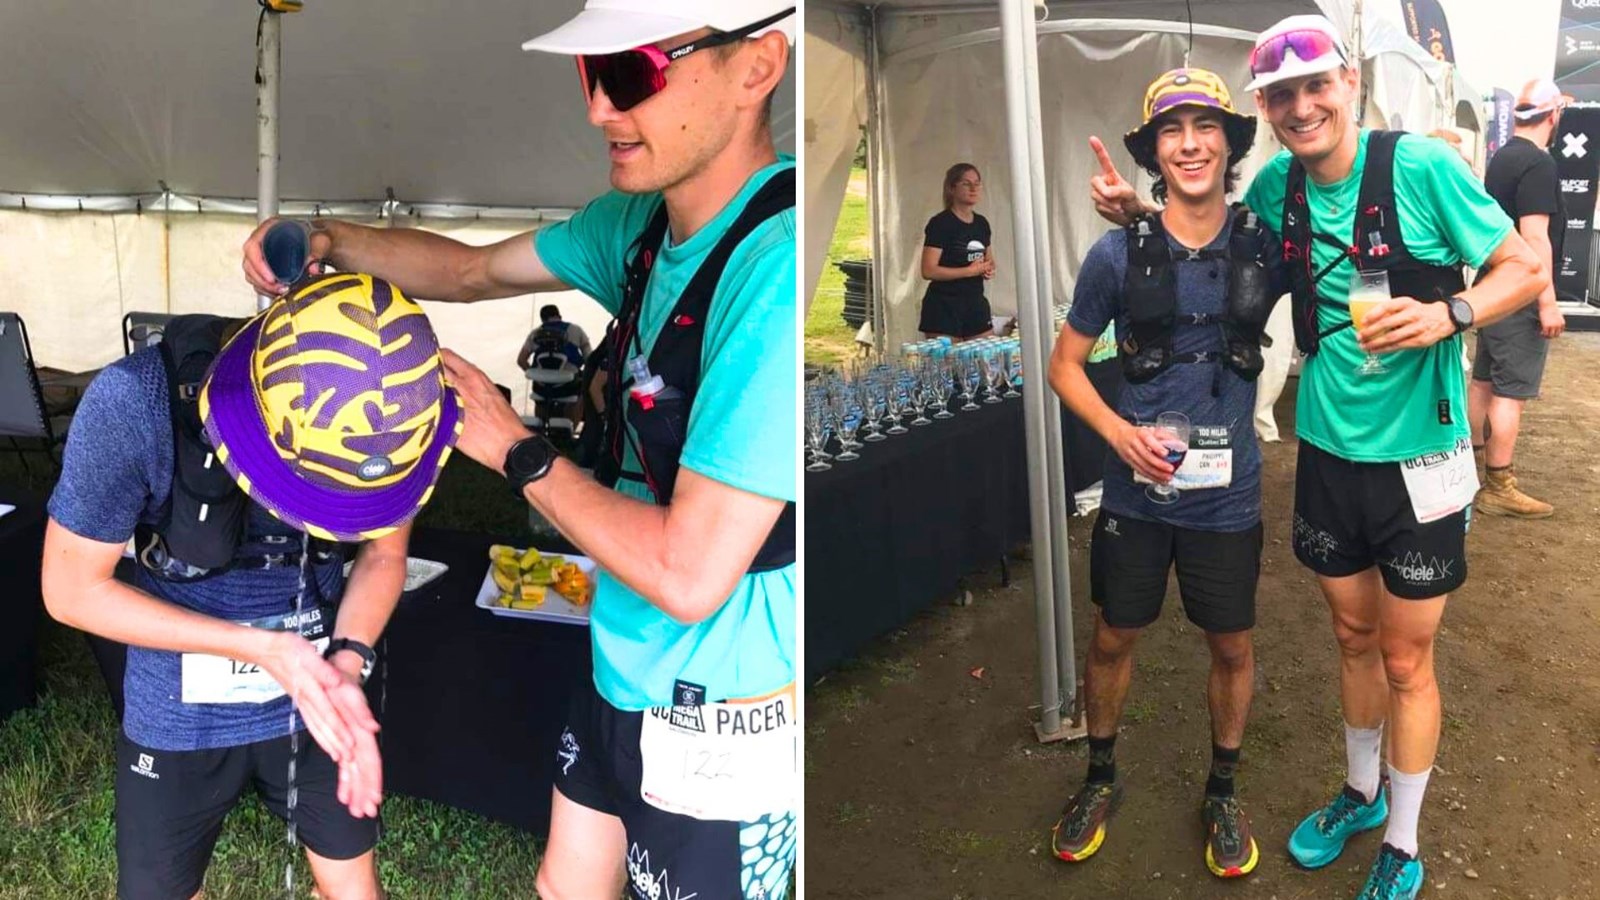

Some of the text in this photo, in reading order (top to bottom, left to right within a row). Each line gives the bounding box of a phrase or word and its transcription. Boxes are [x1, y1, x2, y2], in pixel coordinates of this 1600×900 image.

[1402, 564, 1434, 581] ciele
[283, 609, 321, 629] 100 MILES
[671, 713, 701, 732] TRAIL
[717, 699, 786, 736] PACER
[682, 749, 733, 780] 122
